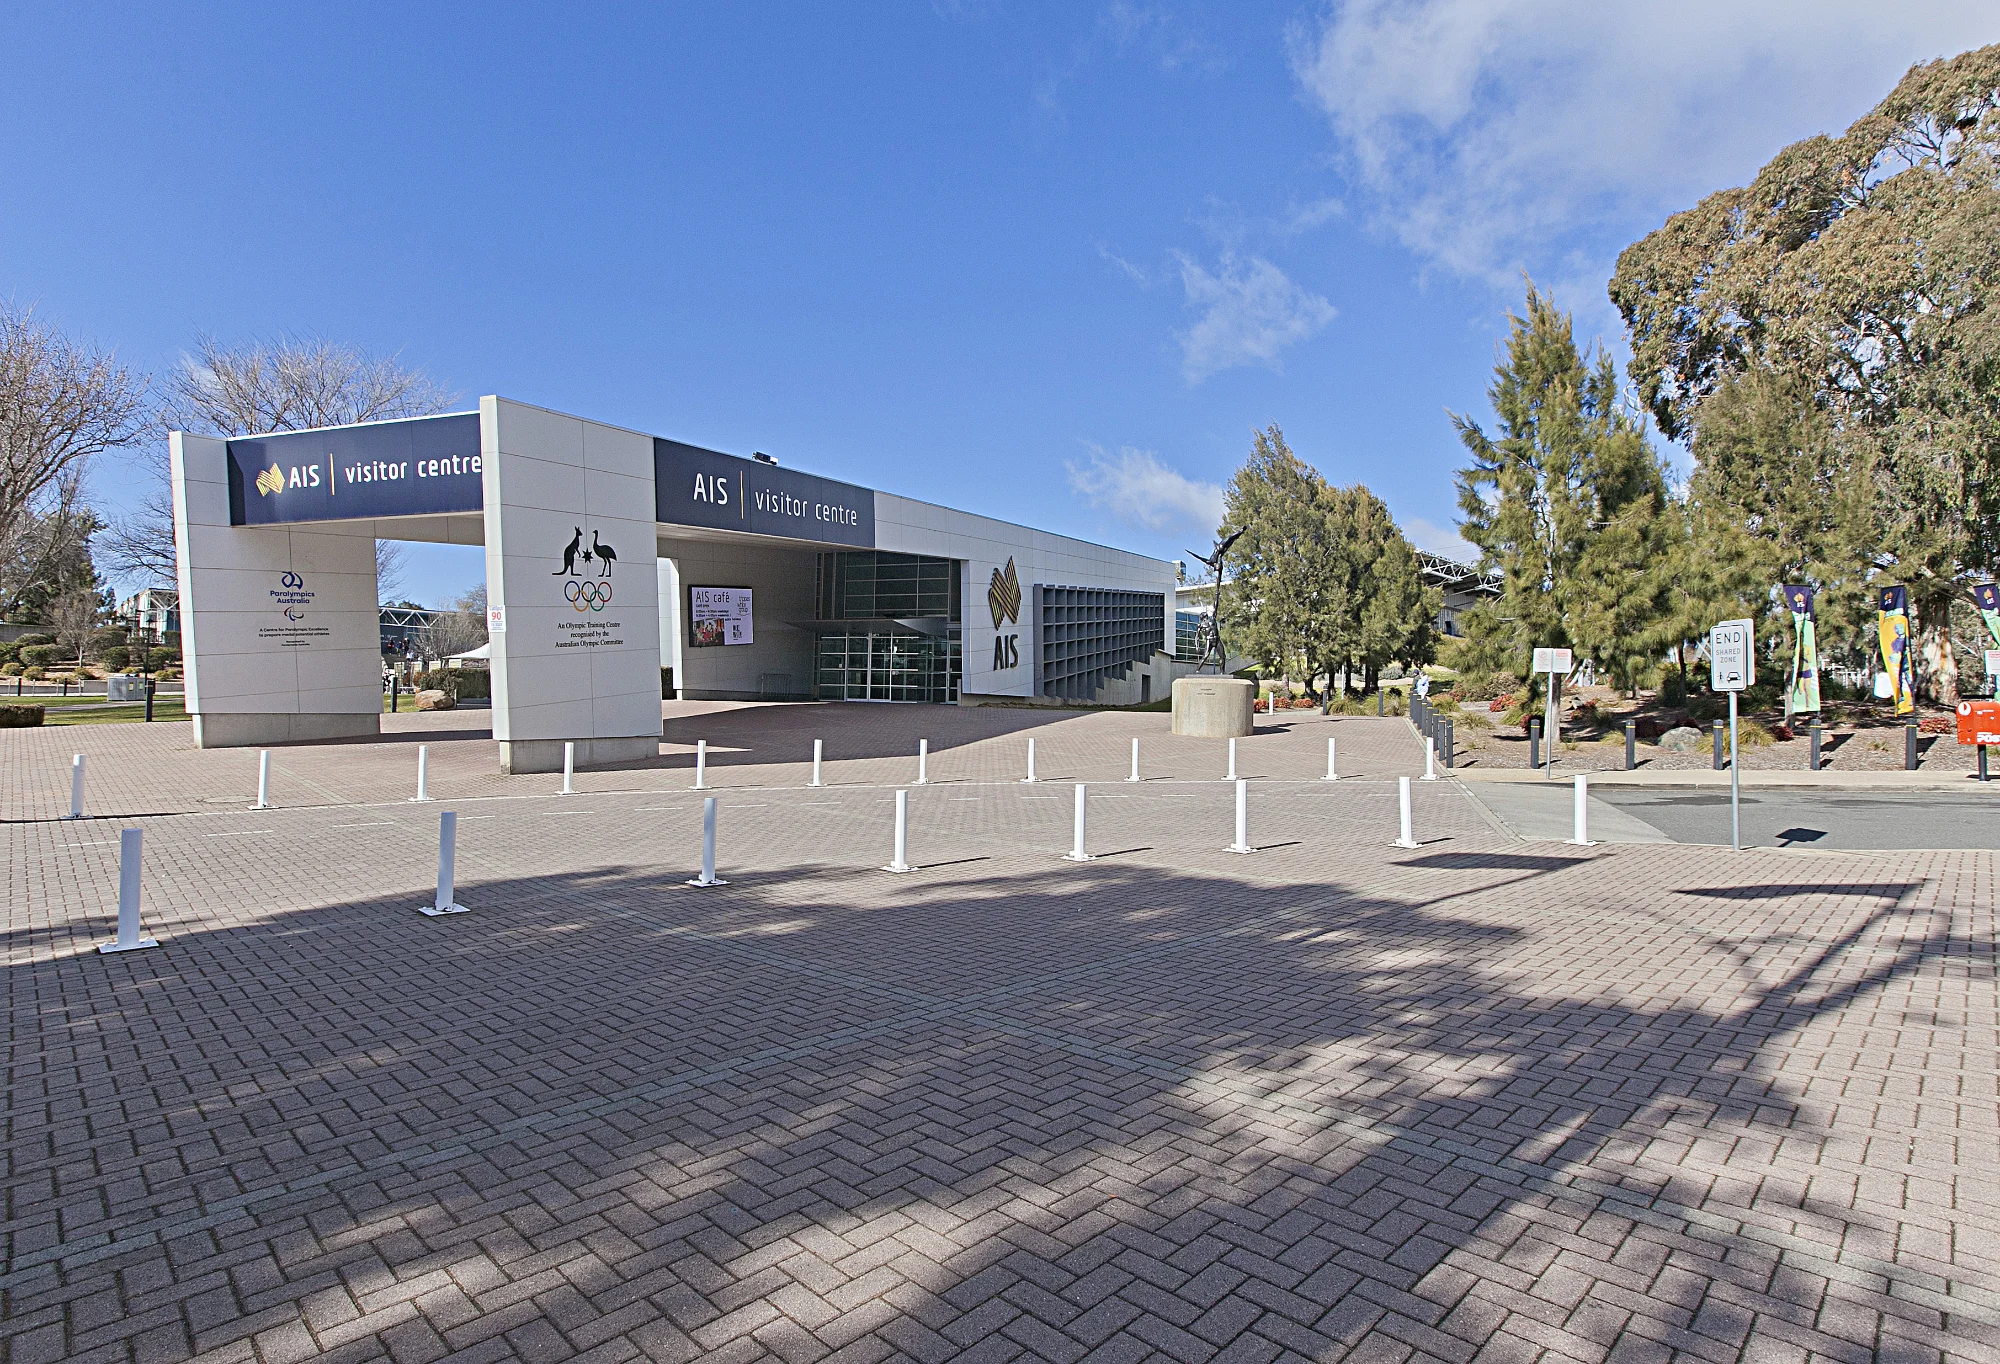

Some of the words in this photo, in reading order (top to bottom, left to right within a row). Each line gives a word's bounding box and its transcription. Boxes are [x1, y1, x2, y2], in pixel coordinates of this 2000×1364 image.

[289, 464, 320, 489] AIS
[344, 460, 408, 484] visitor
[417, 454, 482, 478] centre
[693, 472, 728, 505] AIS
[755, 489, 808, 518] visitor
[815, 500, 858, 526] centre
[696, 591, 710, 602] AIS
[714, 591, 730, 603] café
[492, 612, 501, 620] 90
[566, 622, 586, 630] Olympic
[1716, 632, 1740, 644] END
[993, 634, 1018, 671] AIS
